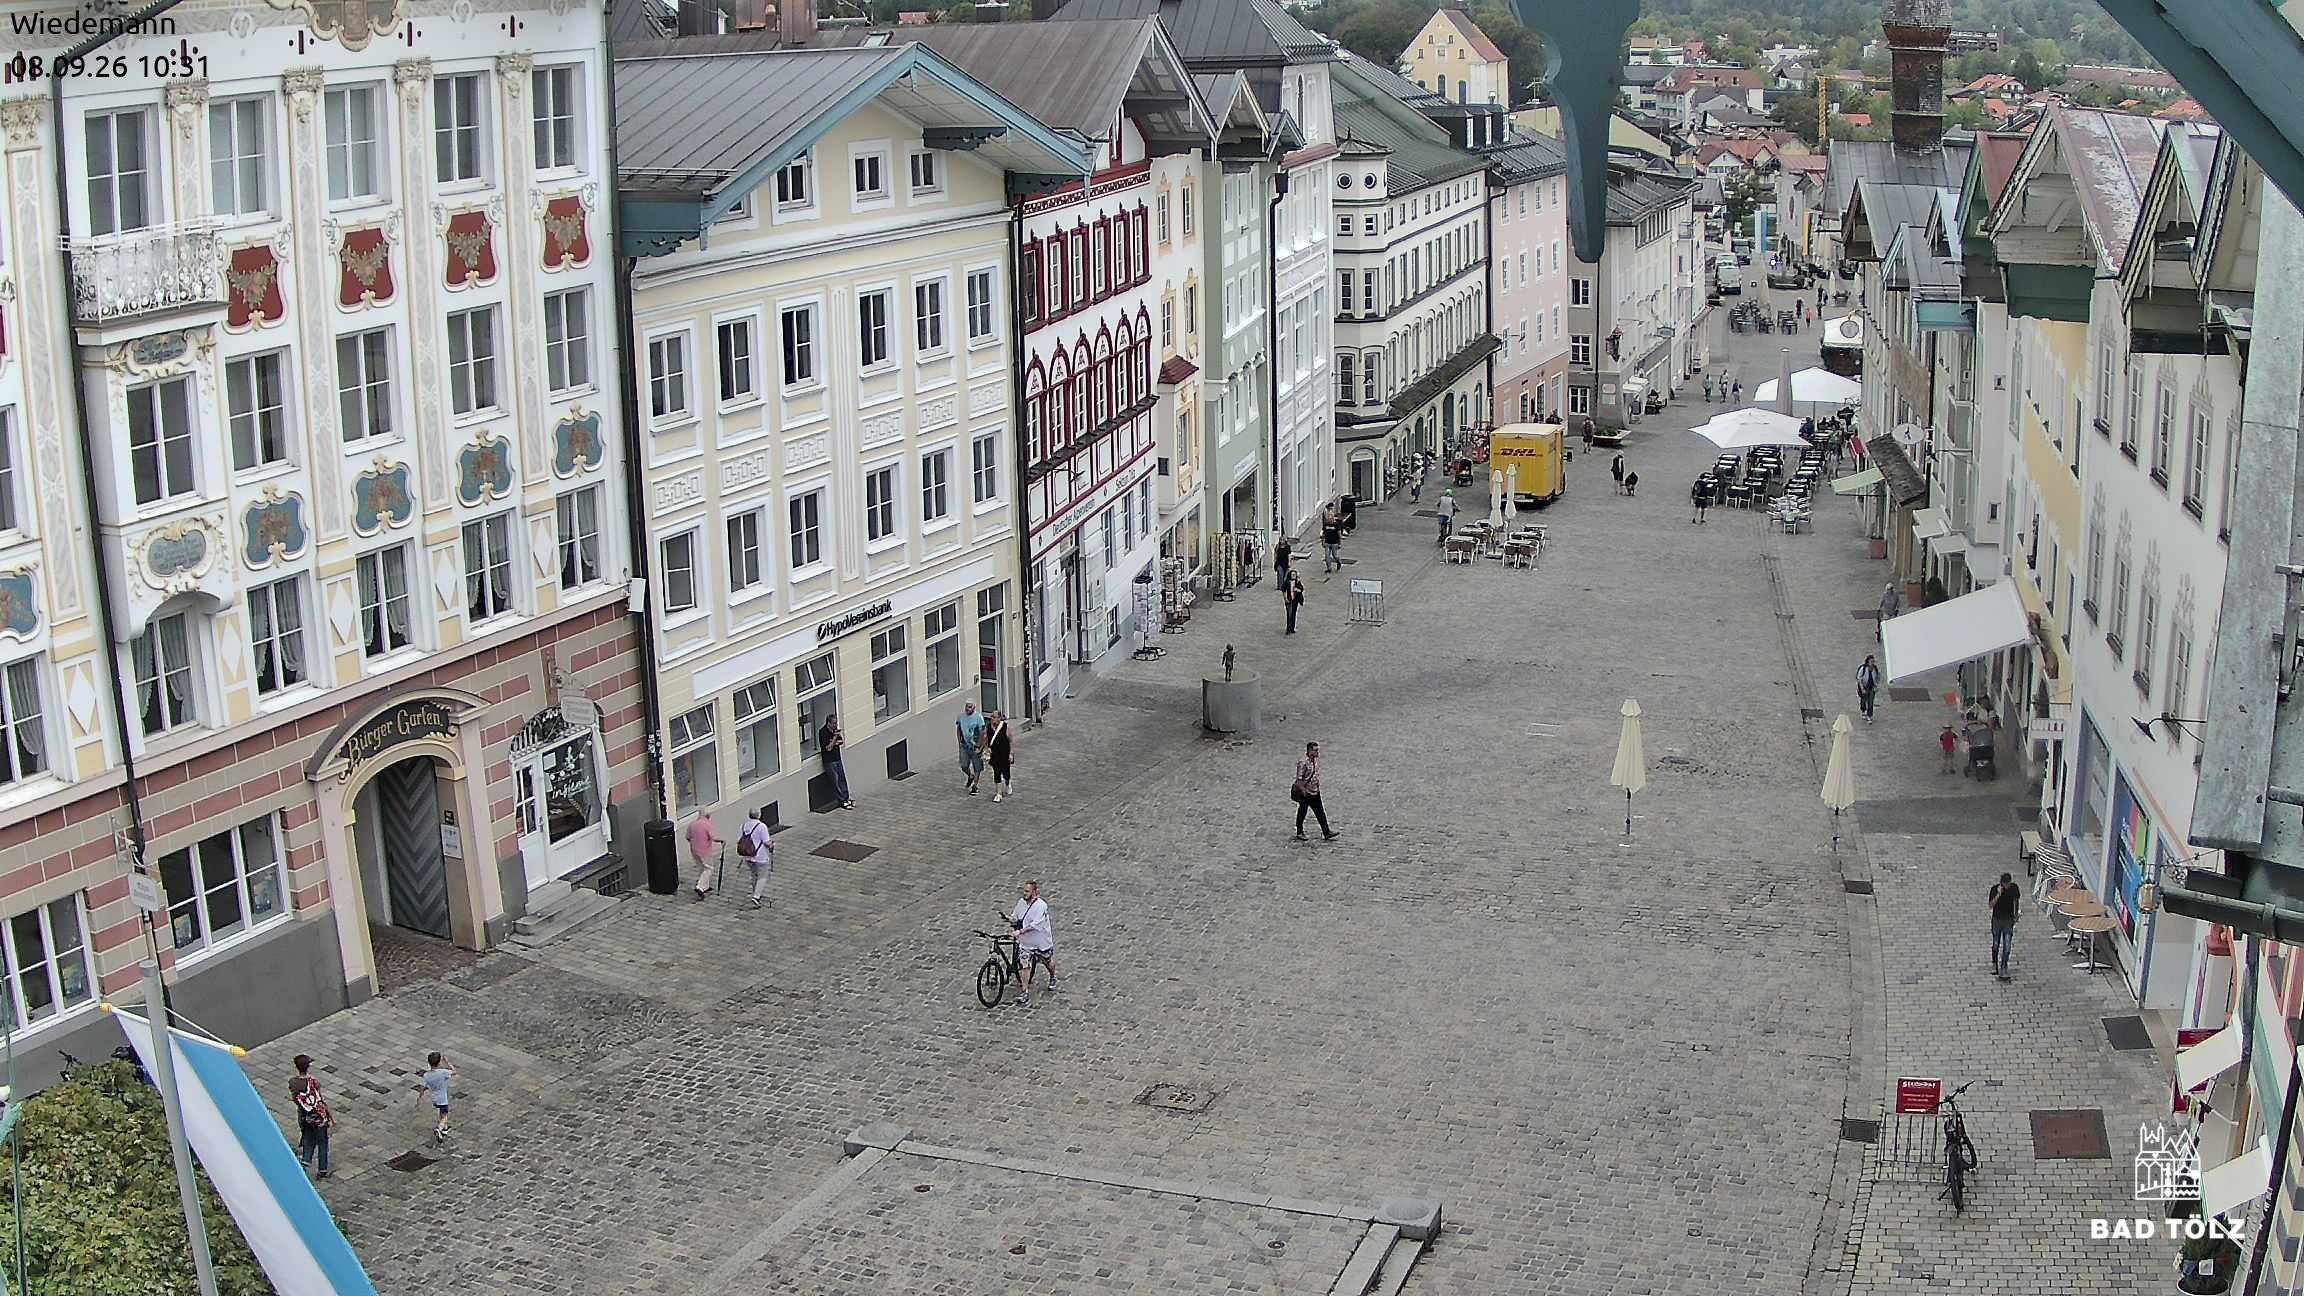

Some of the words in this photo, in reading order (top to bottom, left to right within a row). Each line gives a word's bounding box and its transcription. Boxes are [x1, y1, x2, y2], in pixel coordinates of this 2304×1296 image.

[826, 599, 893, 638] HypoVereinsbank
[348, 719, 393, 769] Bürger
[397, 704, 441, 735] Garten
